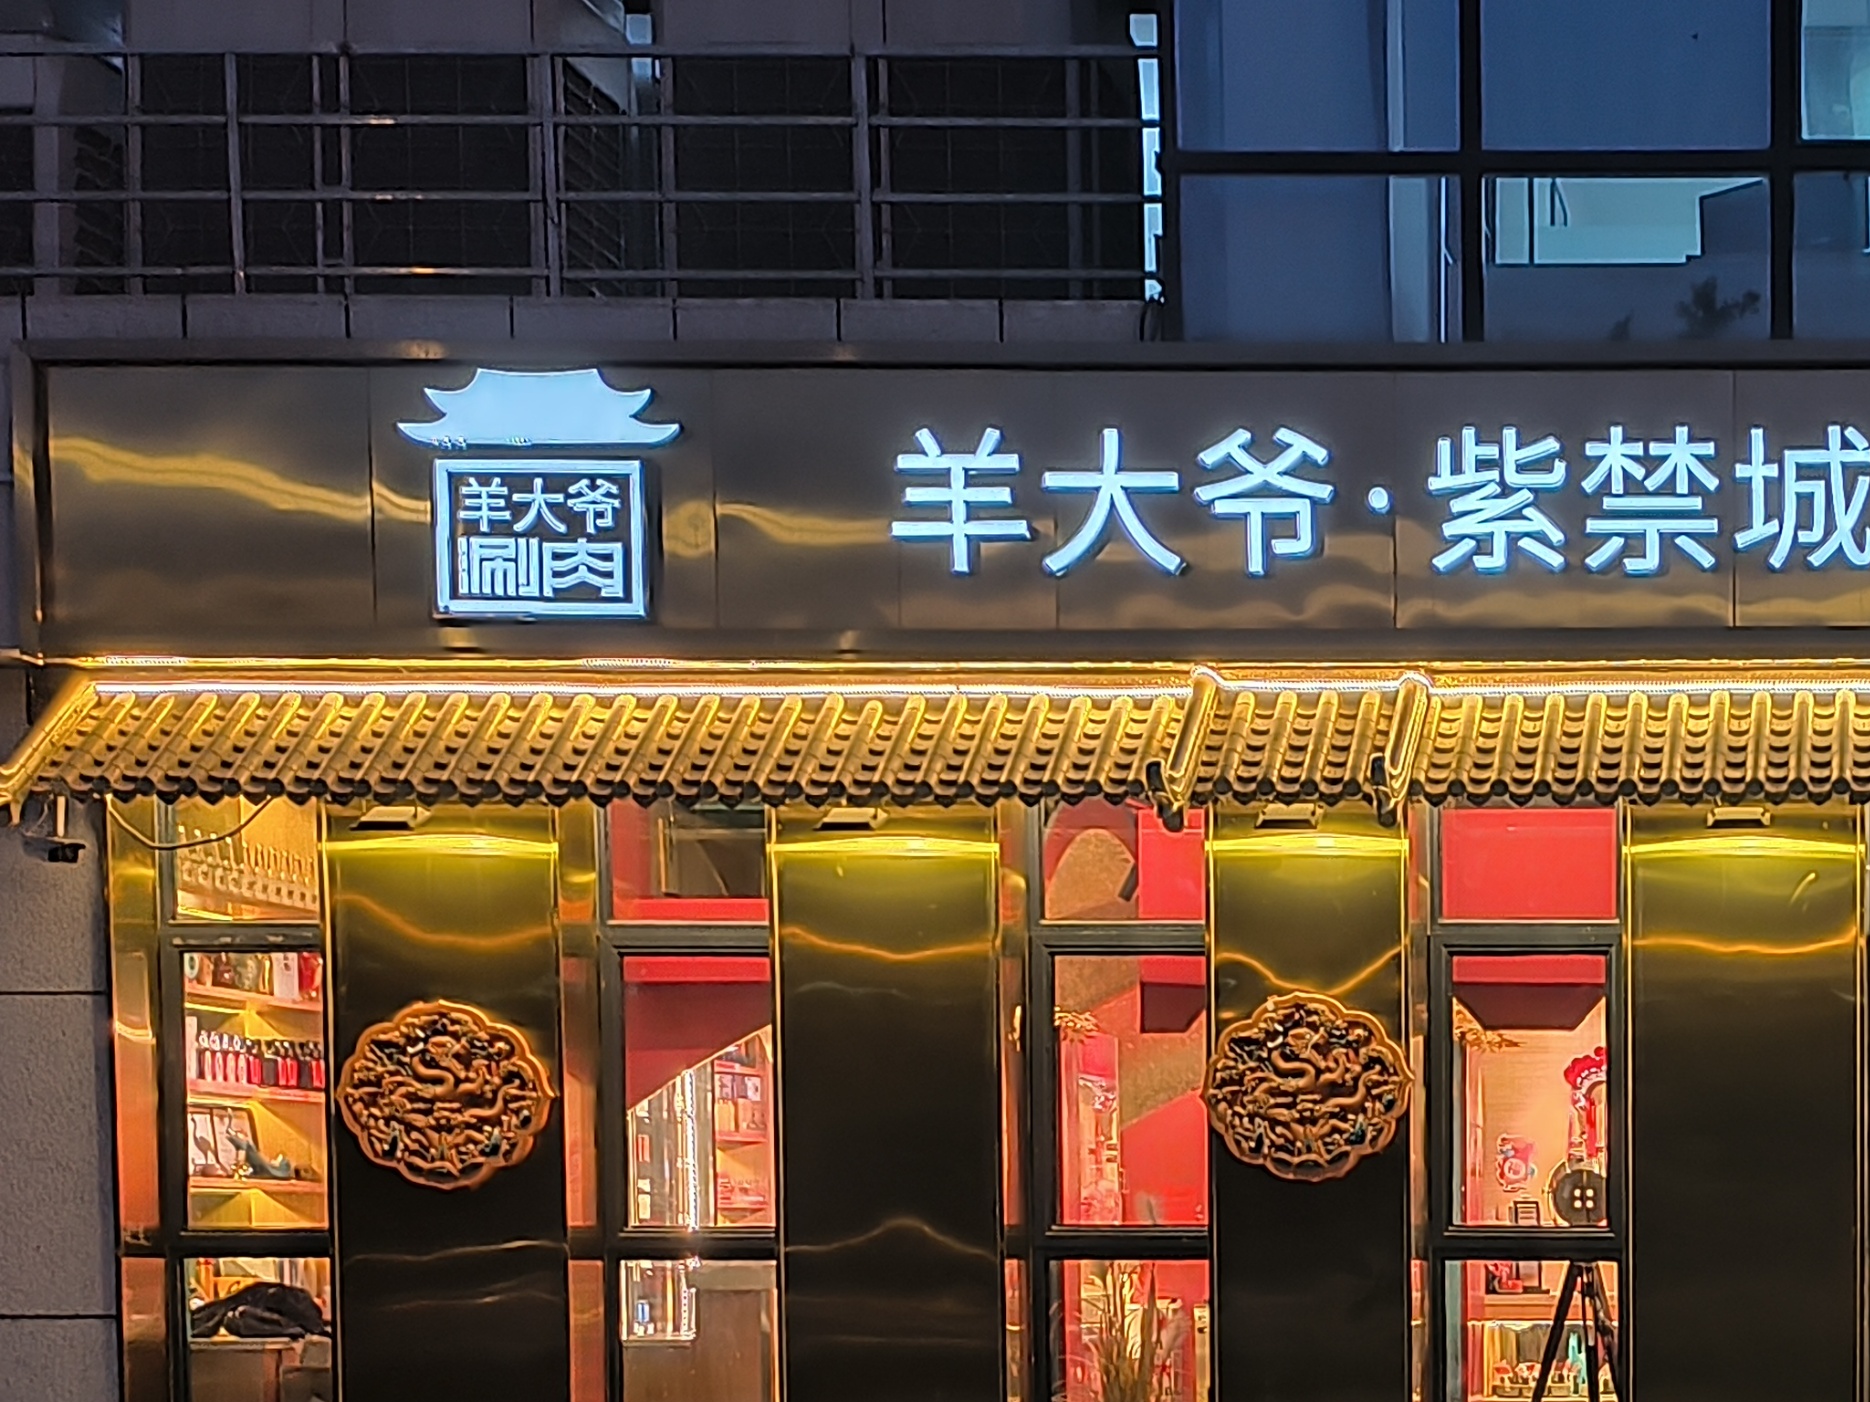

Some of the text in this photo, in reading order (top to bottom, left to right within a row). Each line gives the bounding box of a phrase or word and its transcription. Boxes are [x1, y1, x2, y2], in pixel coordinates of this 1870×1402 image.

[458, 476, 622, 534] 羊大爷
[457, 536, 624, 598] 涮肉
